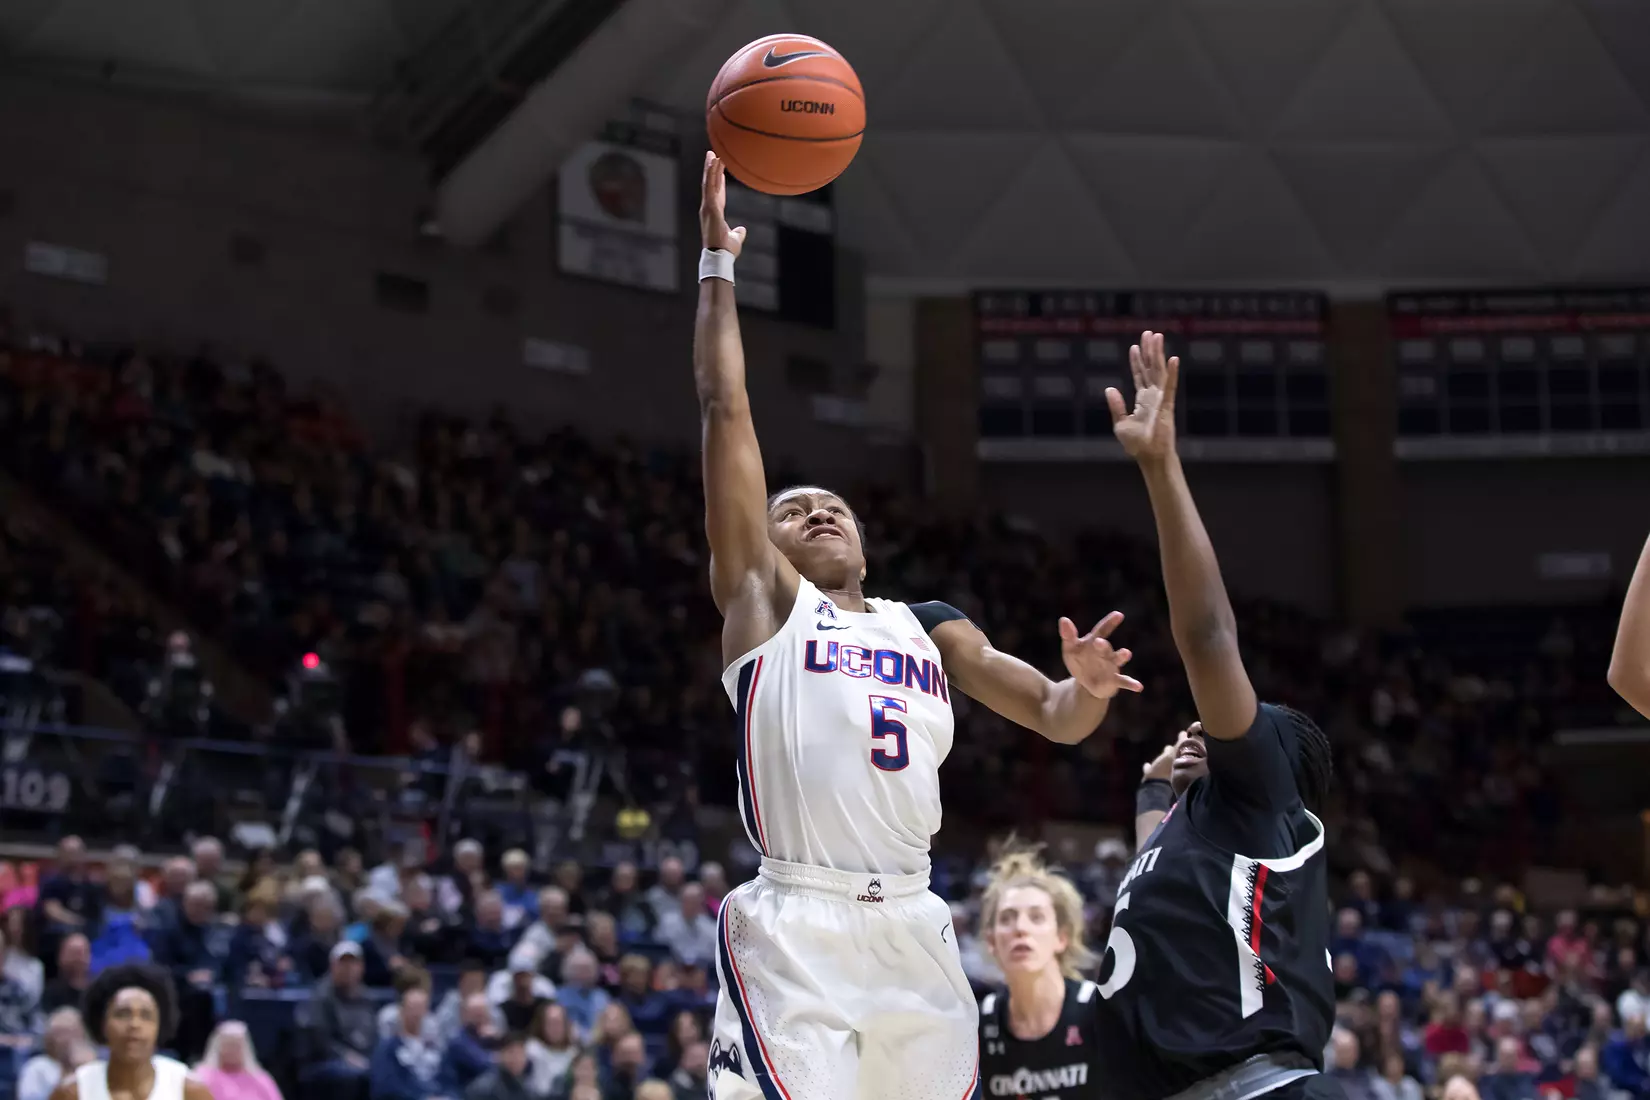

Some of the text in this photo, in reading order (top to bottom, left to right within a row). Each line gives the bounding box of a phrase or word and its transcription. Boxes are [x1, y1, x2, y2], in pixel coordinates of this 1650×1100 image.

[781, 100, 834, 114] UCONN
[804, 640, 949, 704] UCONN
[868, 695, 910, 771] 5
[989, 1062, 1089, 1096] CINCINNATI
